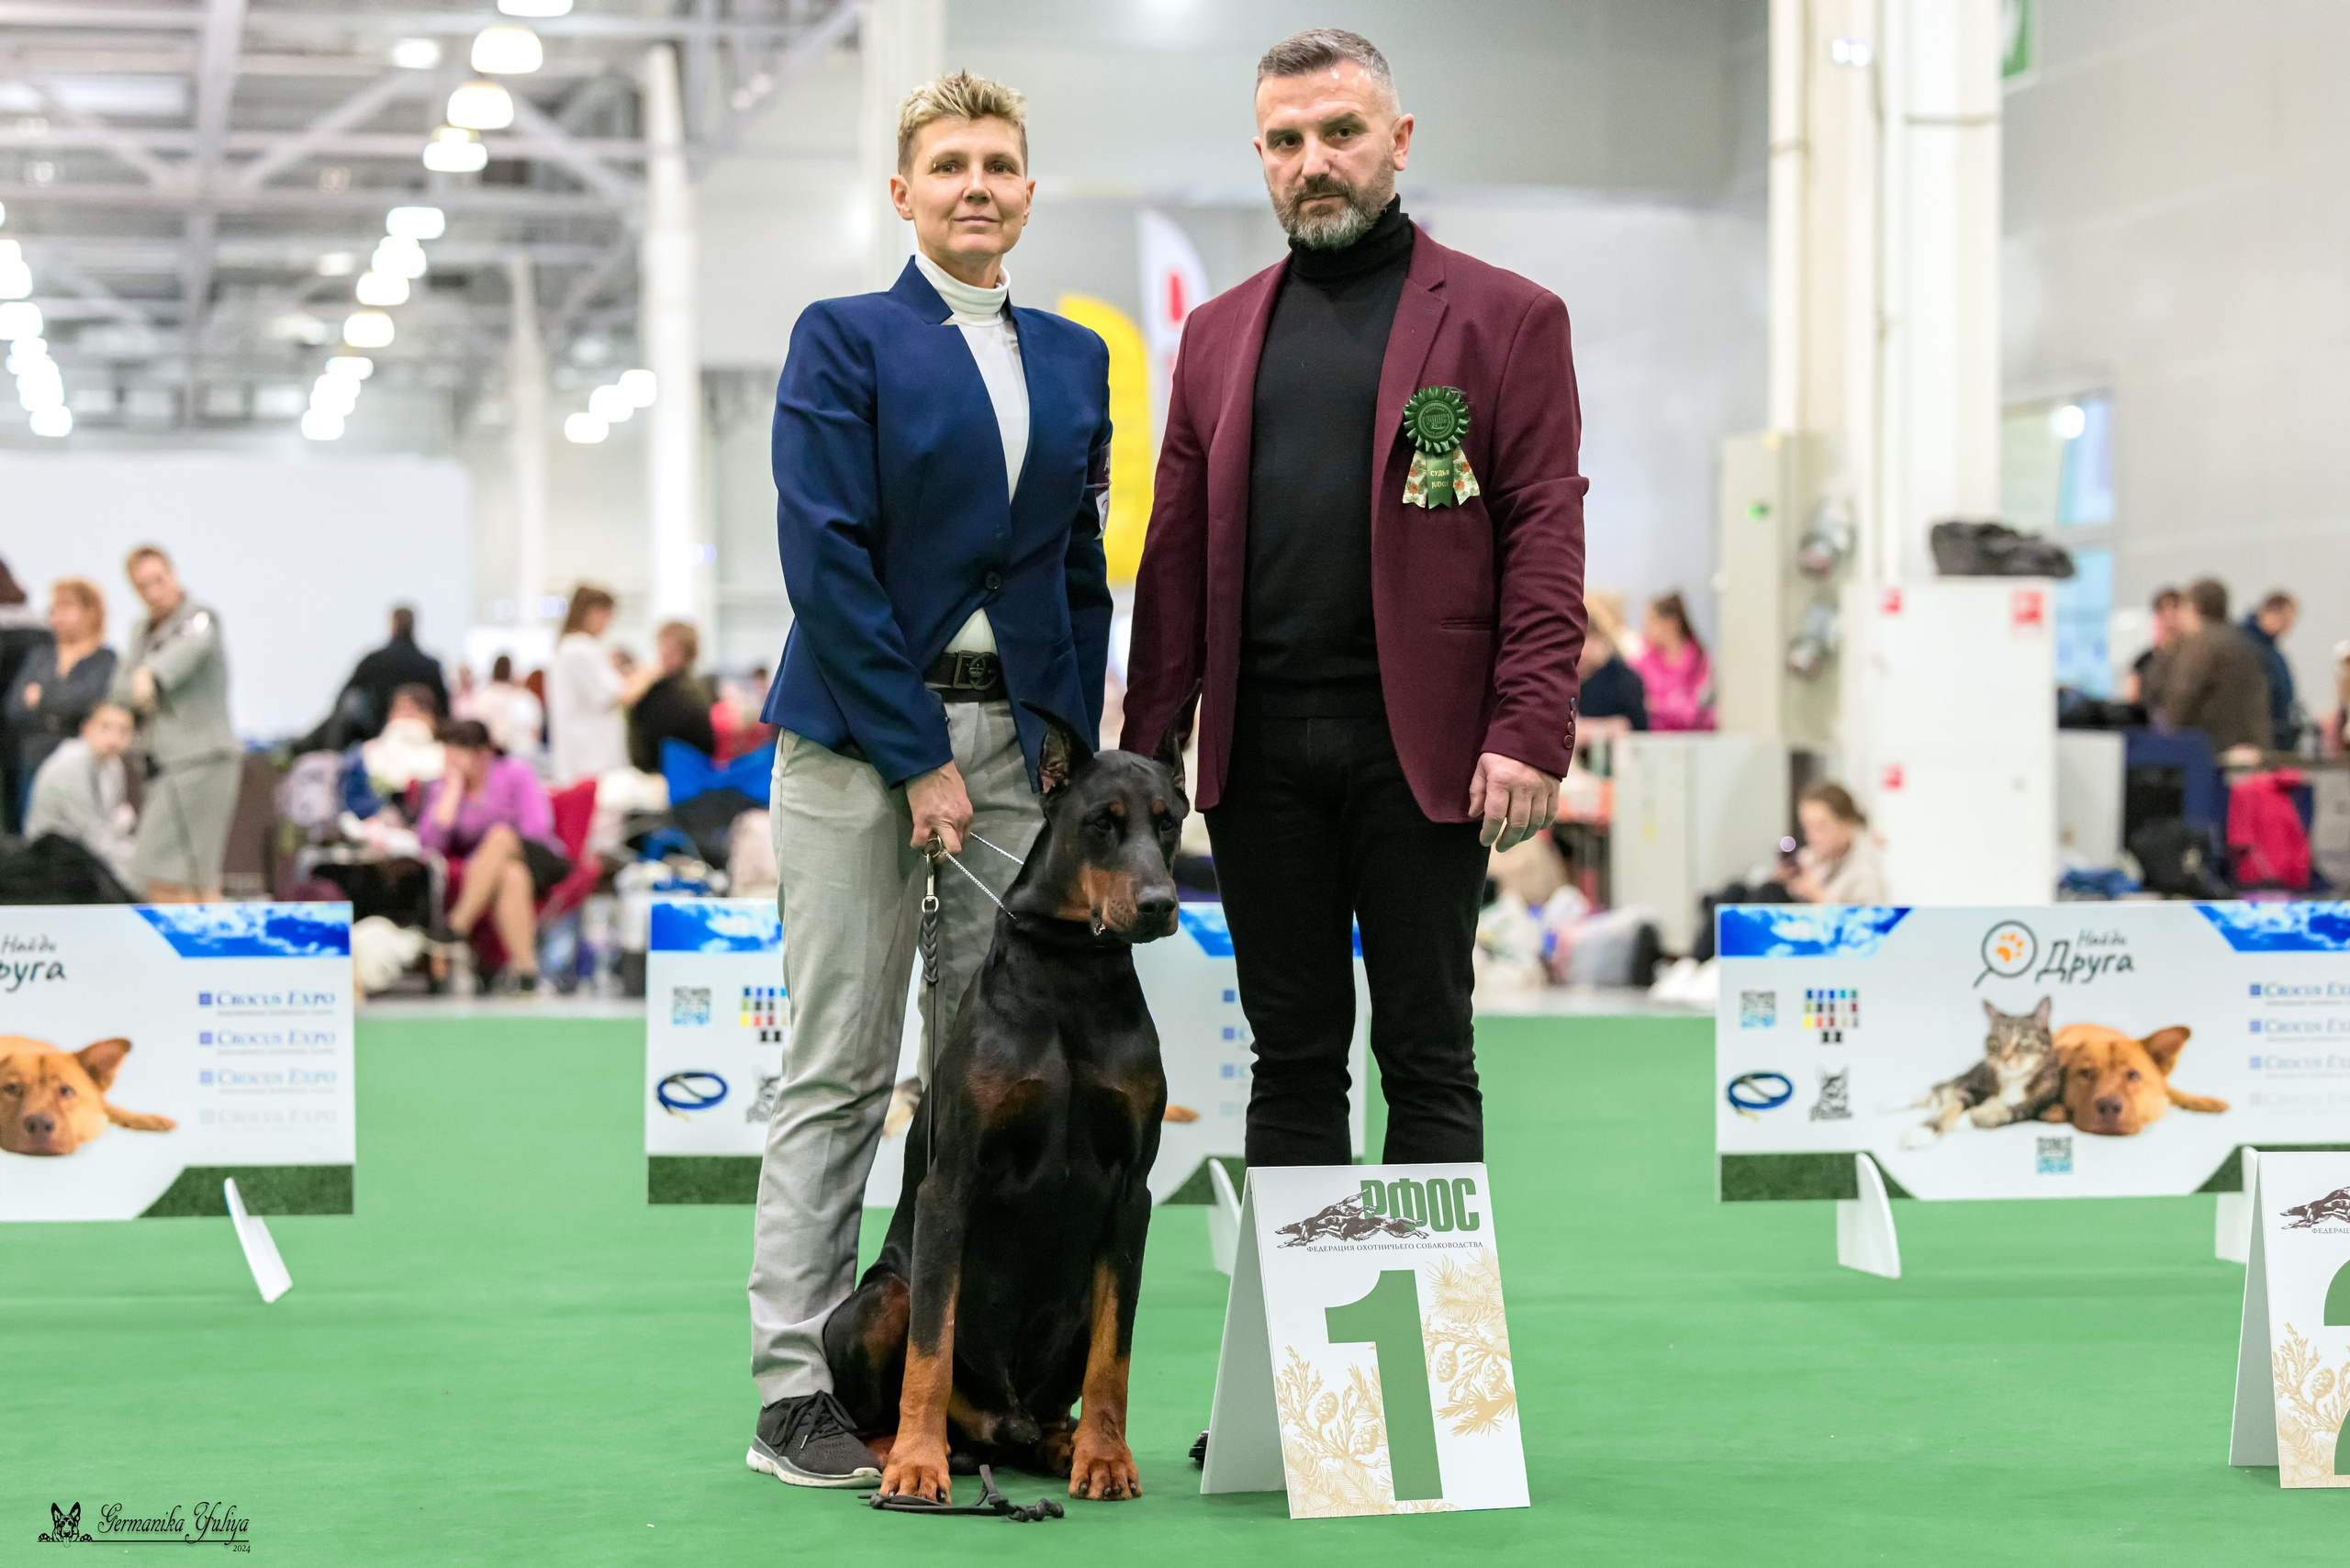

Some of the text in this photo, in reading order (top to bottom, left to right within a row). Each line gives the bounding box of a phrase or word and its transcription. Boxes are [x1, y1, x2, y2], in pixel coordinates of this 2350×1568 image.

[1430, 469, 1449, 477] СУДЬЯ
[2034, 939, 2134, 984] Друга
[217, 990, 336, 1007] CROCUS EXPO
[1360, 1178, 1480, 1232] РФОС
[1357, 1243, 1415, 1251] ОХОТНИЧЬЕГО
[1416, 1241, 1483, 1249] СОБАКОВОДСТВА
[1325, 1270, 1443, 1501] 1
